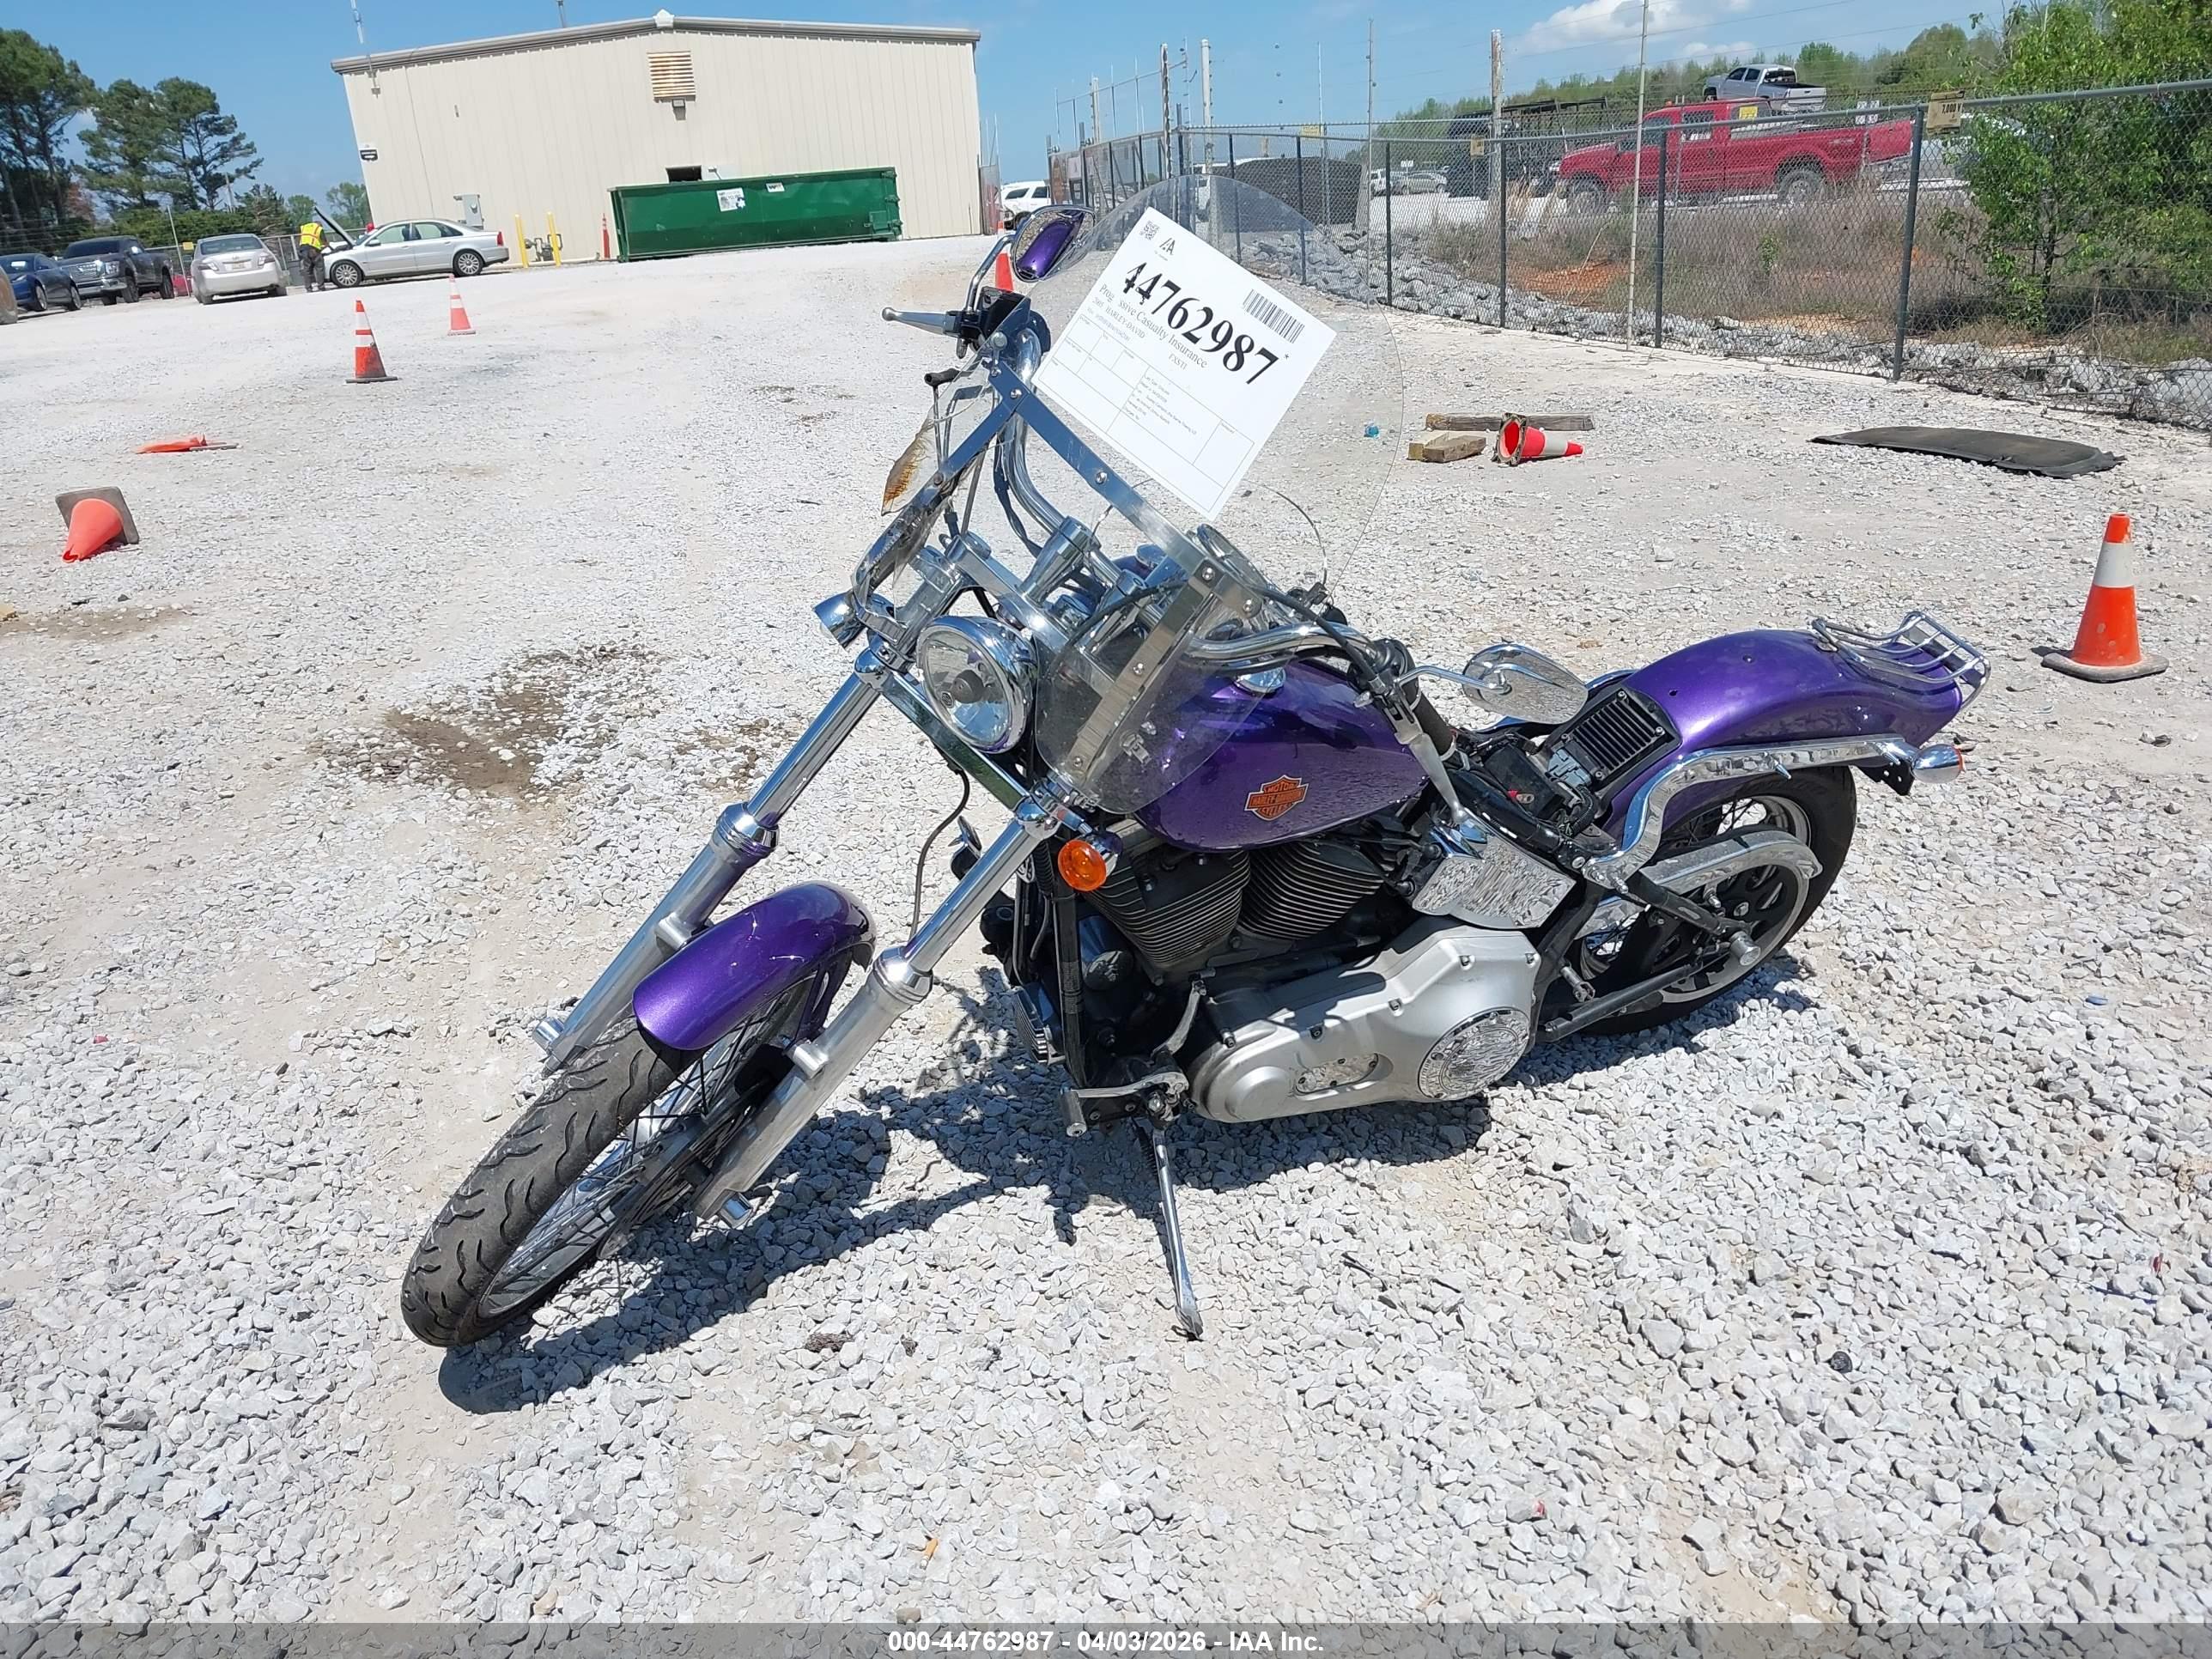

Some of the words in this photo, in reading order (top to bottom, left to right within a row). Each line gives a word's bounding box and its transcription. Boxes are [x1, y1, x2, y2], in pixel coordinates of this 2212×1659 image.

[1942, 104, 1957, 114] 7,000
[1099, 283, 1137, 315] Progssive
[1136, 311, 1170, 342] Casualty
[1169, 336, 1207, 369] Insurance
[1123, 262, 1279, 385] 44762987
